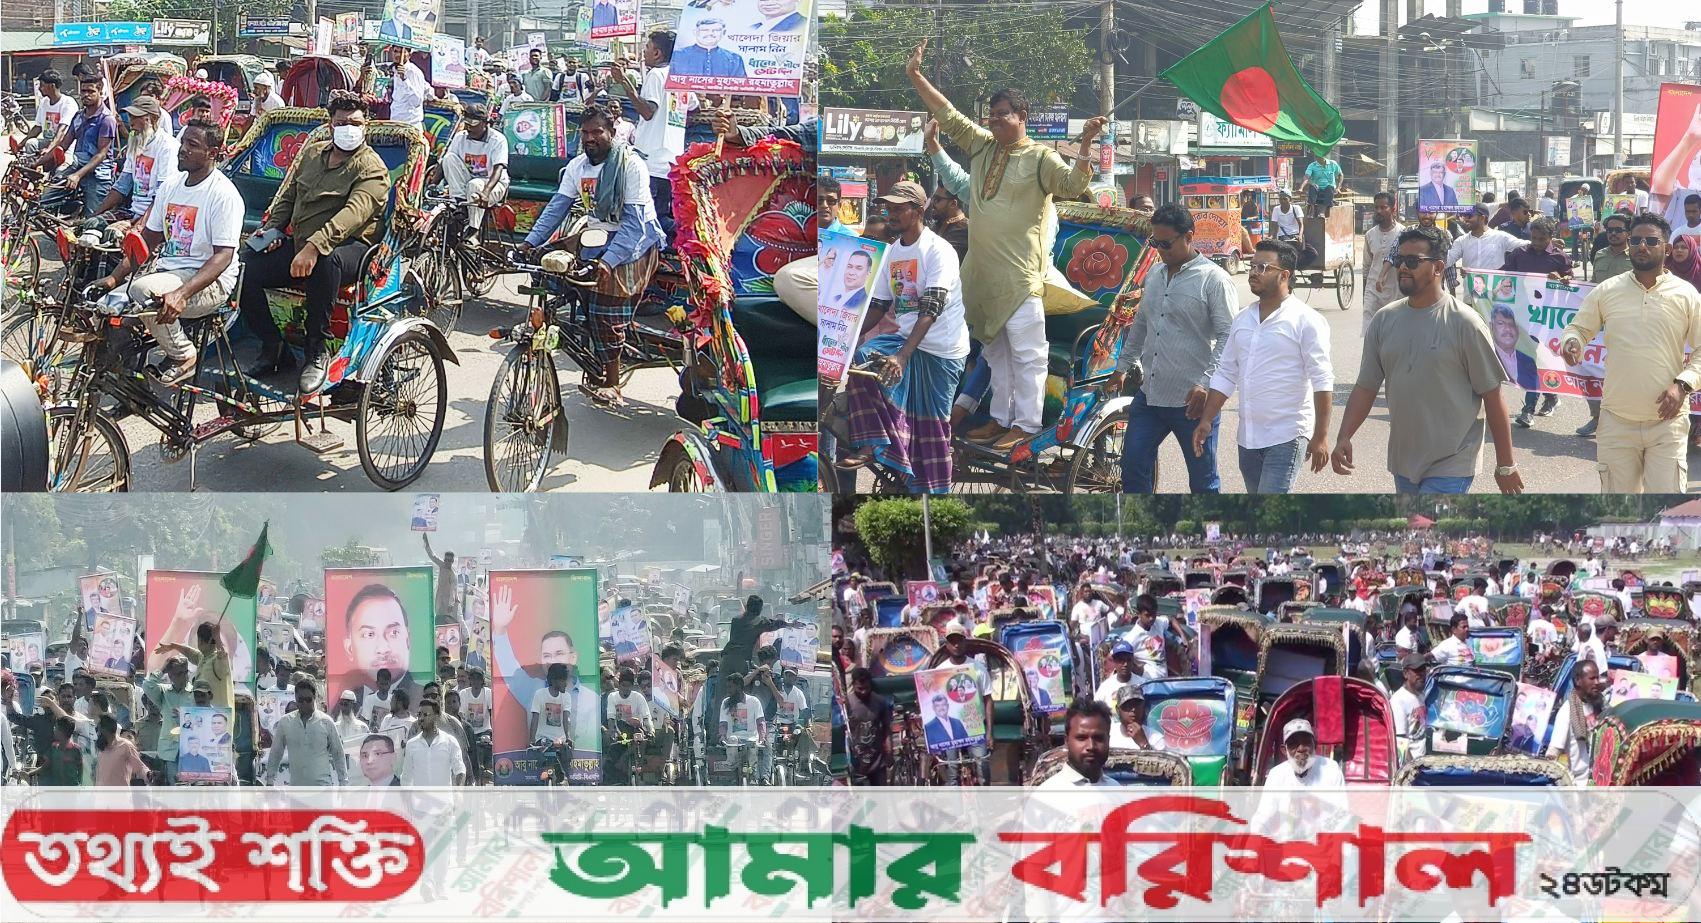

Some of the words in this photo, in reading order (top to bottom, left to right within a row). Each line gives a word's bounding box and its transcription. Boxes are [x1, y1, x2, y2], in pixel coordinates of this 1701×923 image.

[727, 34, 763, 42] খালেদা
[738, 45, 767, 53] সালাম
[769, 43, 786, 53] নিন
[825, 112, 863, 141] Lily
[1563, 375, 1589, 396] আবু
